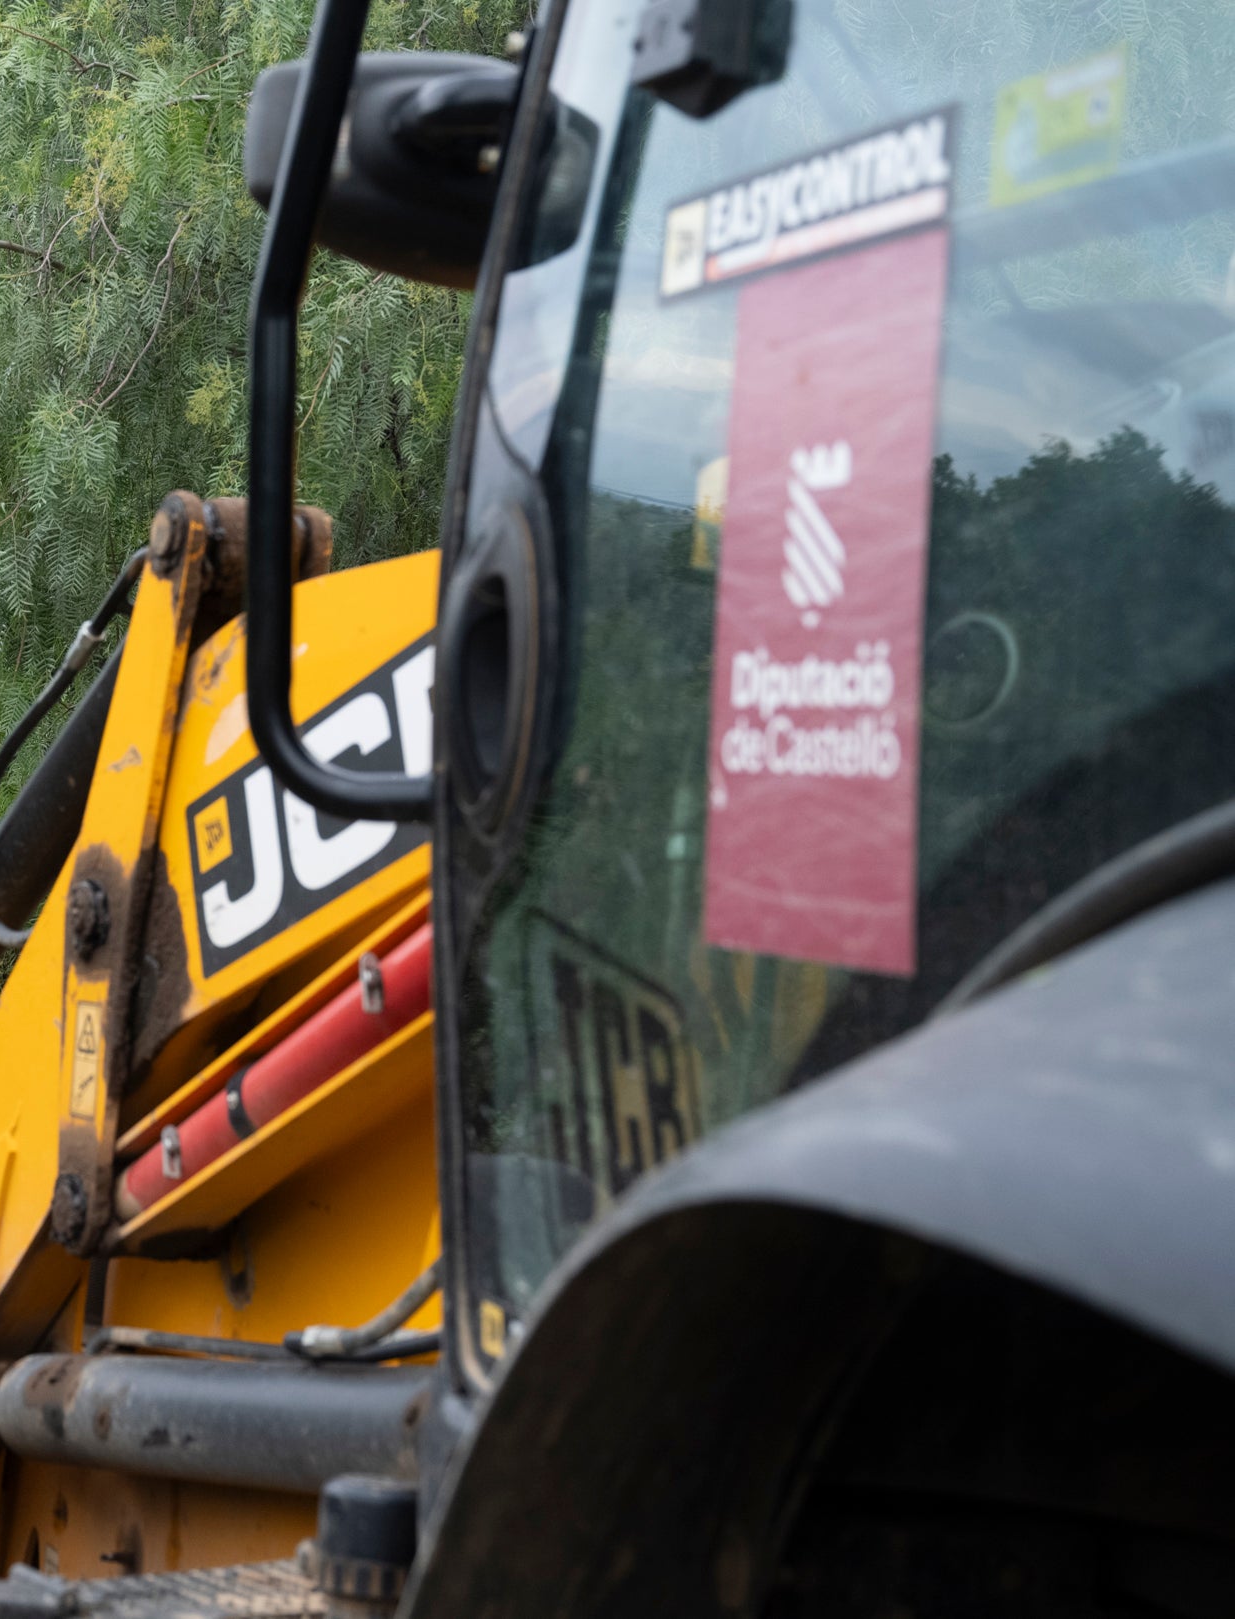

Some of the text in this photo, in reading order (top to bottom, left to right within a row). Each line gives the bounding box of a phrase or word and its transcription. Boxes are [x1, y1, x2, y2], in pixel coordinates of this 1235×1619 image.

[707, 116, 950, 257] EASYCONTROL
[729, 641, 895, 720] Diputació
[720, 713, 902, 779] de Castelló
